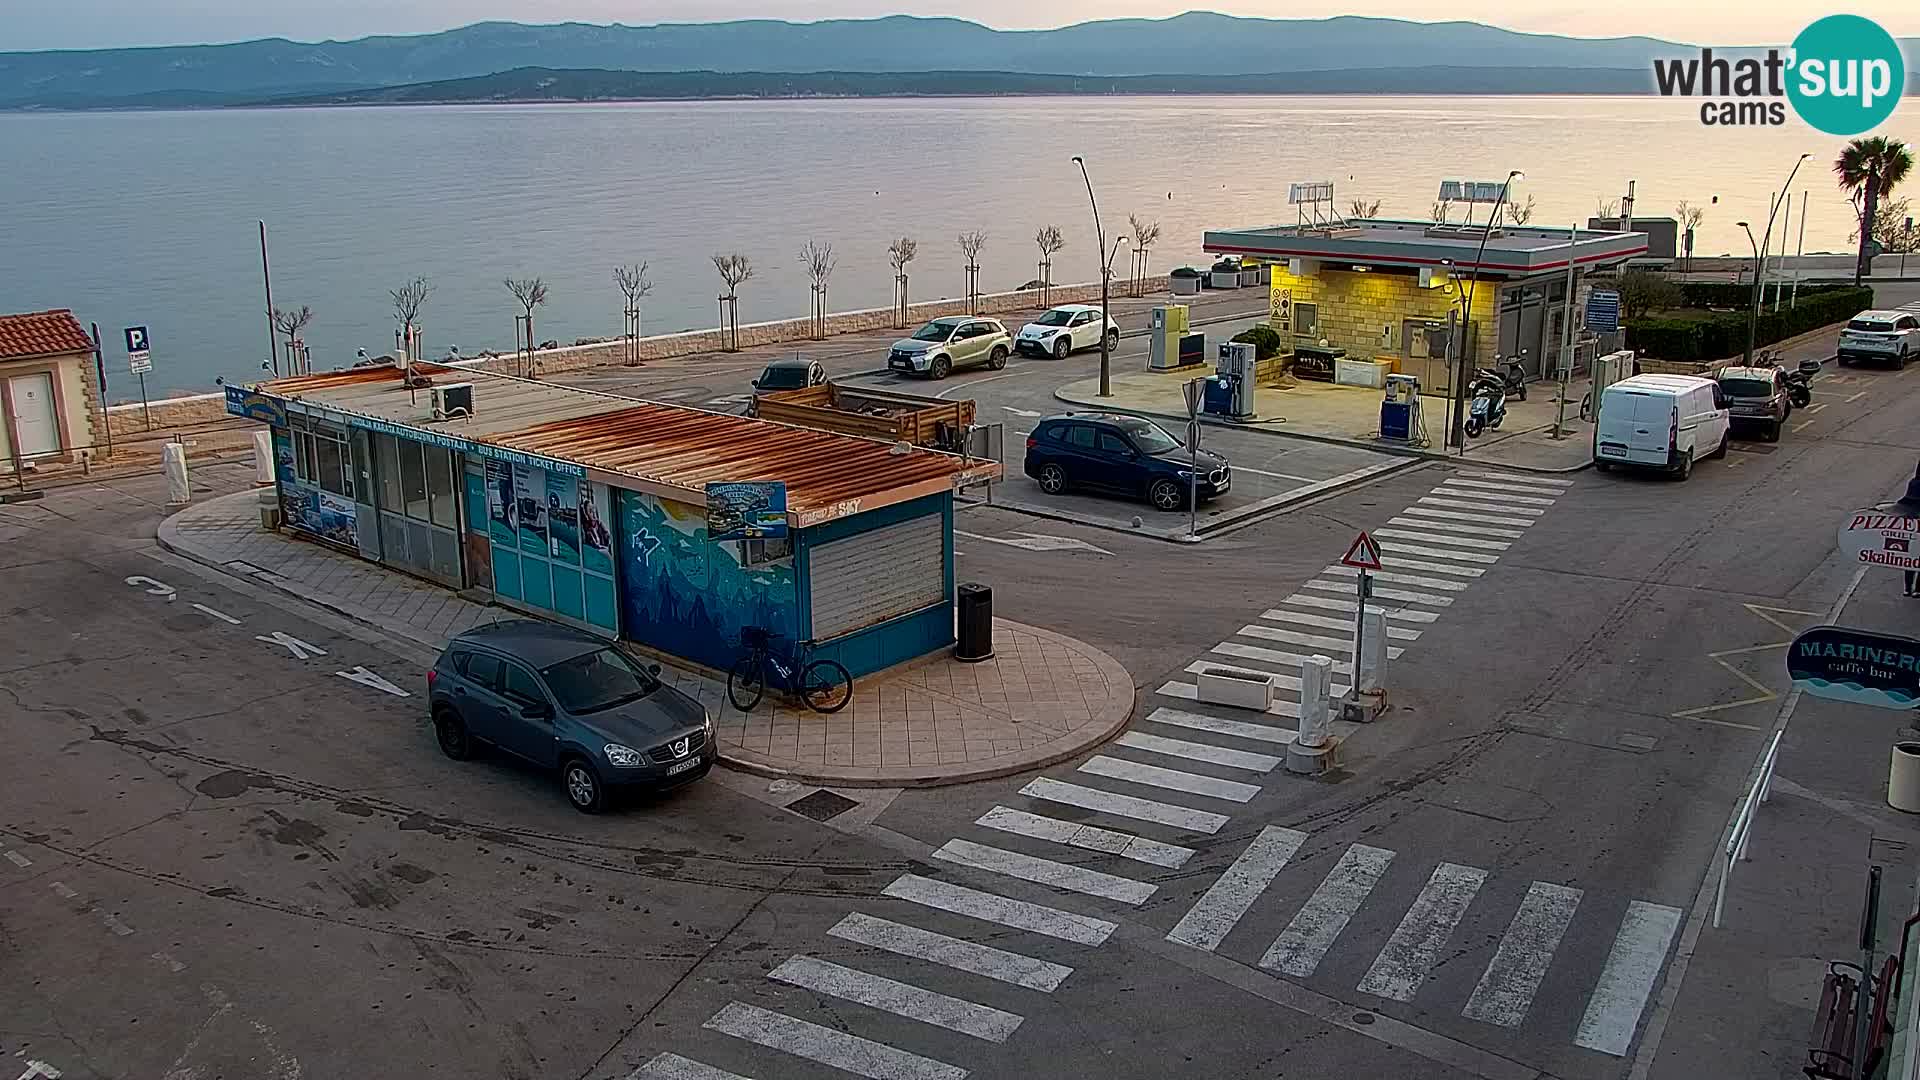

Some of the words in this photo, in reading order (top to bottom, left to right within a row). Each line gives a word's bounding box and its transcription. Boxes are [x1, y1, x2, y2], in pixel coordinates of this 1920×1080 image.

[130, 330, 143, 349] P
[395, 426, 436, 444] AUTOBUSNA
[436, 434, 468, 452] POSTAJA
[478, 445, 493, 457] BUS
[494, 448, 526, 465] STATION
[527, 456, 554, 471] TICKET
[555, 463, 582, 477] OFFICE
[1881, 530, 1917, 540] GRILL
[1869, 664, 1896, 680] bar
